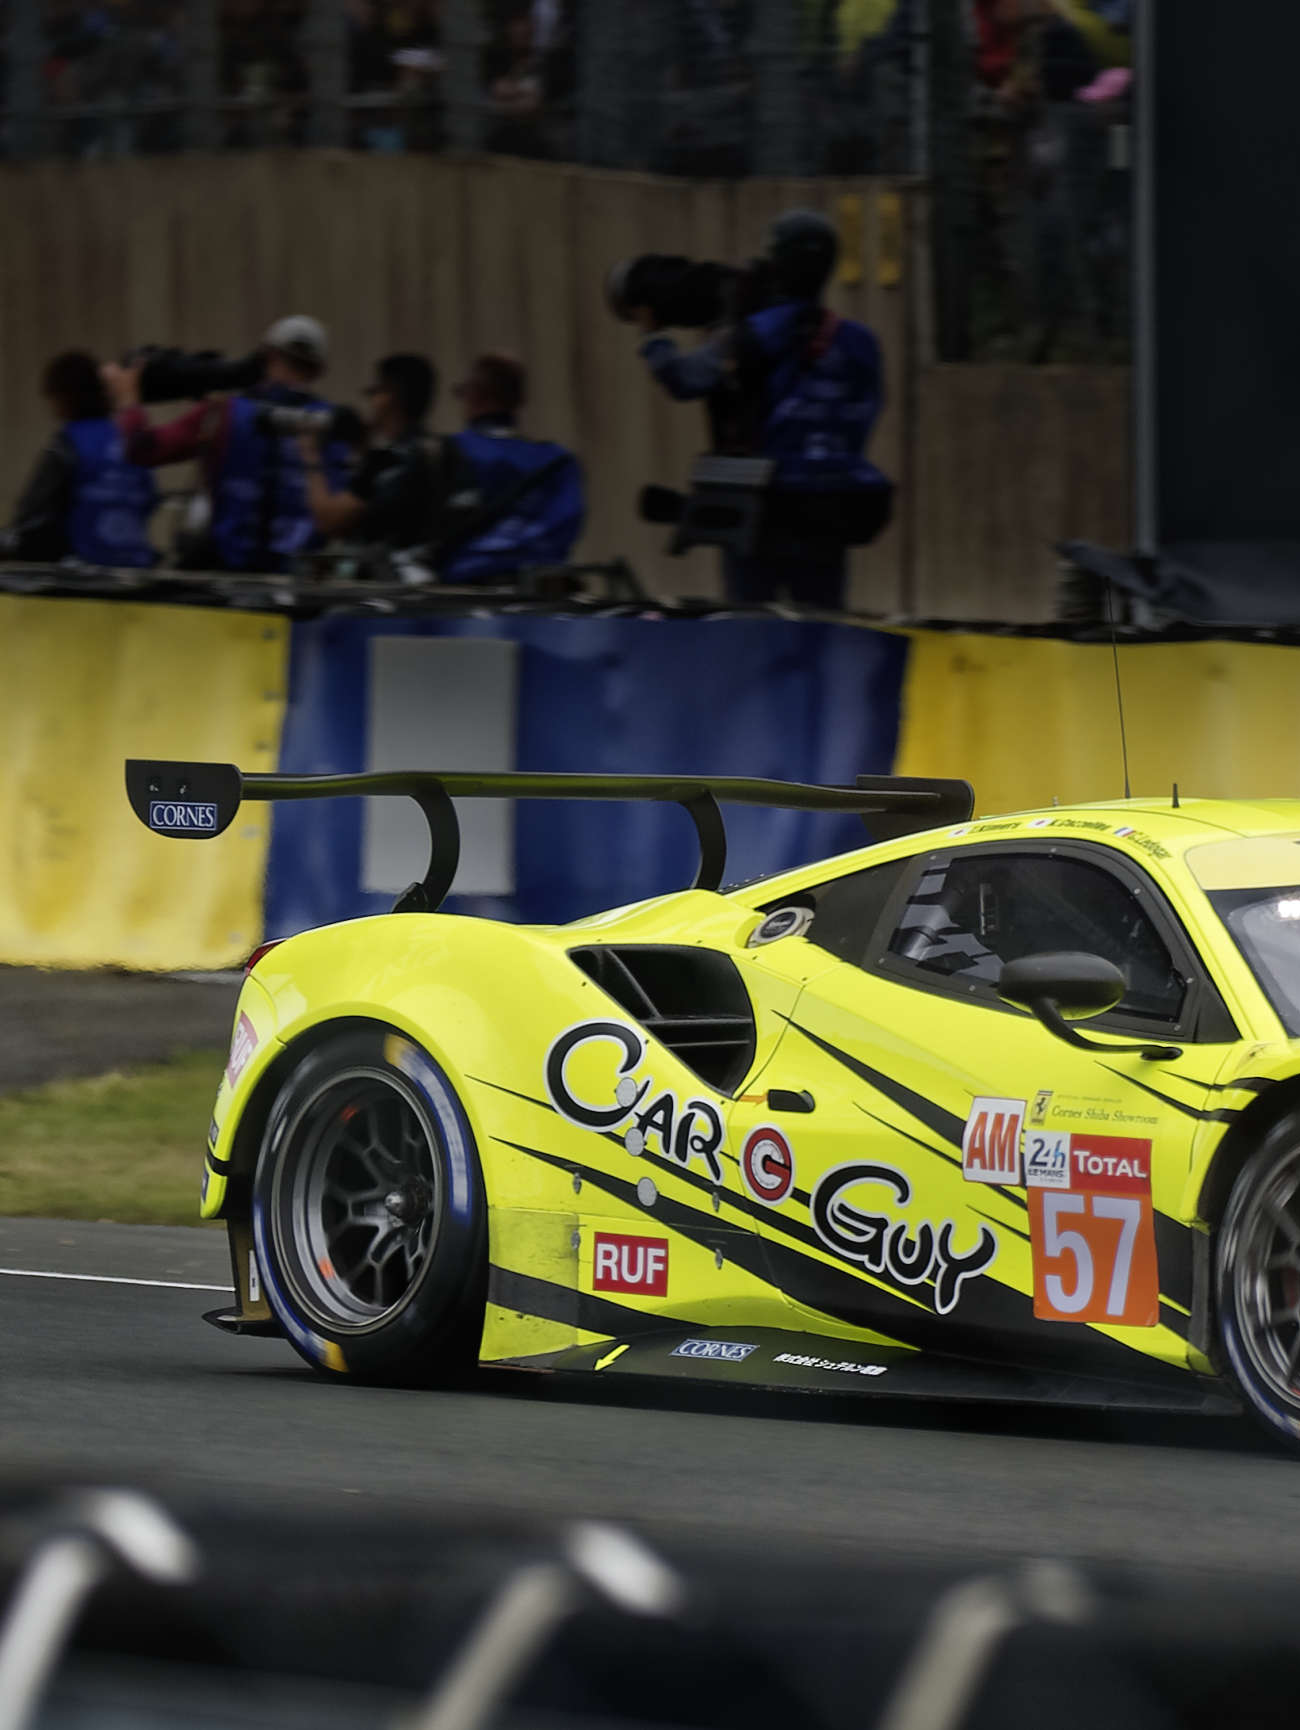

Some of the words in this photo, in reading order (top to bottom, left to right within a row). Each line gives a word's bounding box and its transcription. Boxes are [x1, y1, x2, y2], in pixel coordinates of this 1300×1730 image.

[153, 804, 214, 827] CORNES
[546, 1021, 722, 1181] CAR
[966, 1111, 1020, 1173] AM
[1073, 1150, 1148, 1179] TOTAL
[596, 1243, 666, 1284] RUF
[1042, 1192, 1141, 1317] 57
[678, 1341, 752, 1359] CORNES
